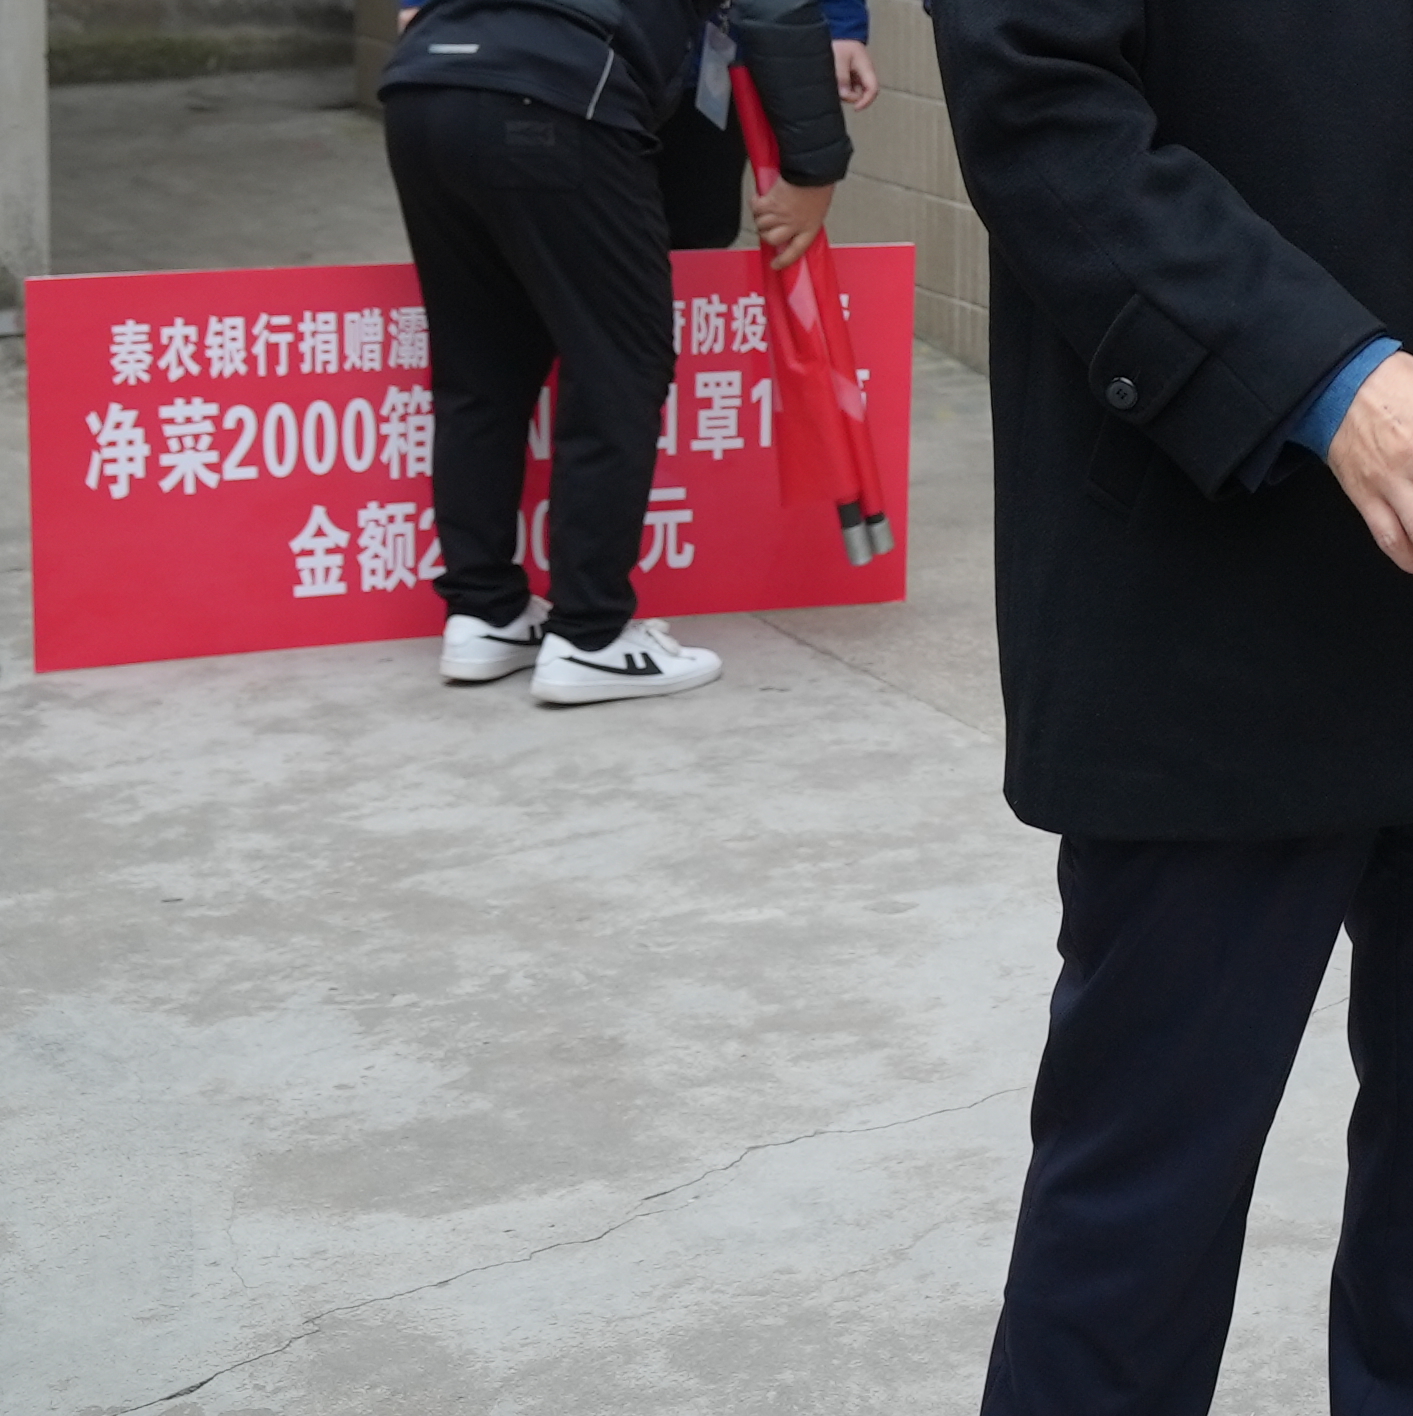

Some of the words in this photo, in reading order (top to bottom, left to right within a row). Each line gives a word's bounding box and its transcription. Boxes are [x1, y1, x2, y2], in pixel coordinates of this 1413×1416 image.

[109, 305, 430, 386] 秦农银行捐赠灞
[85, 384, 436, 500] 净菜2000箱
